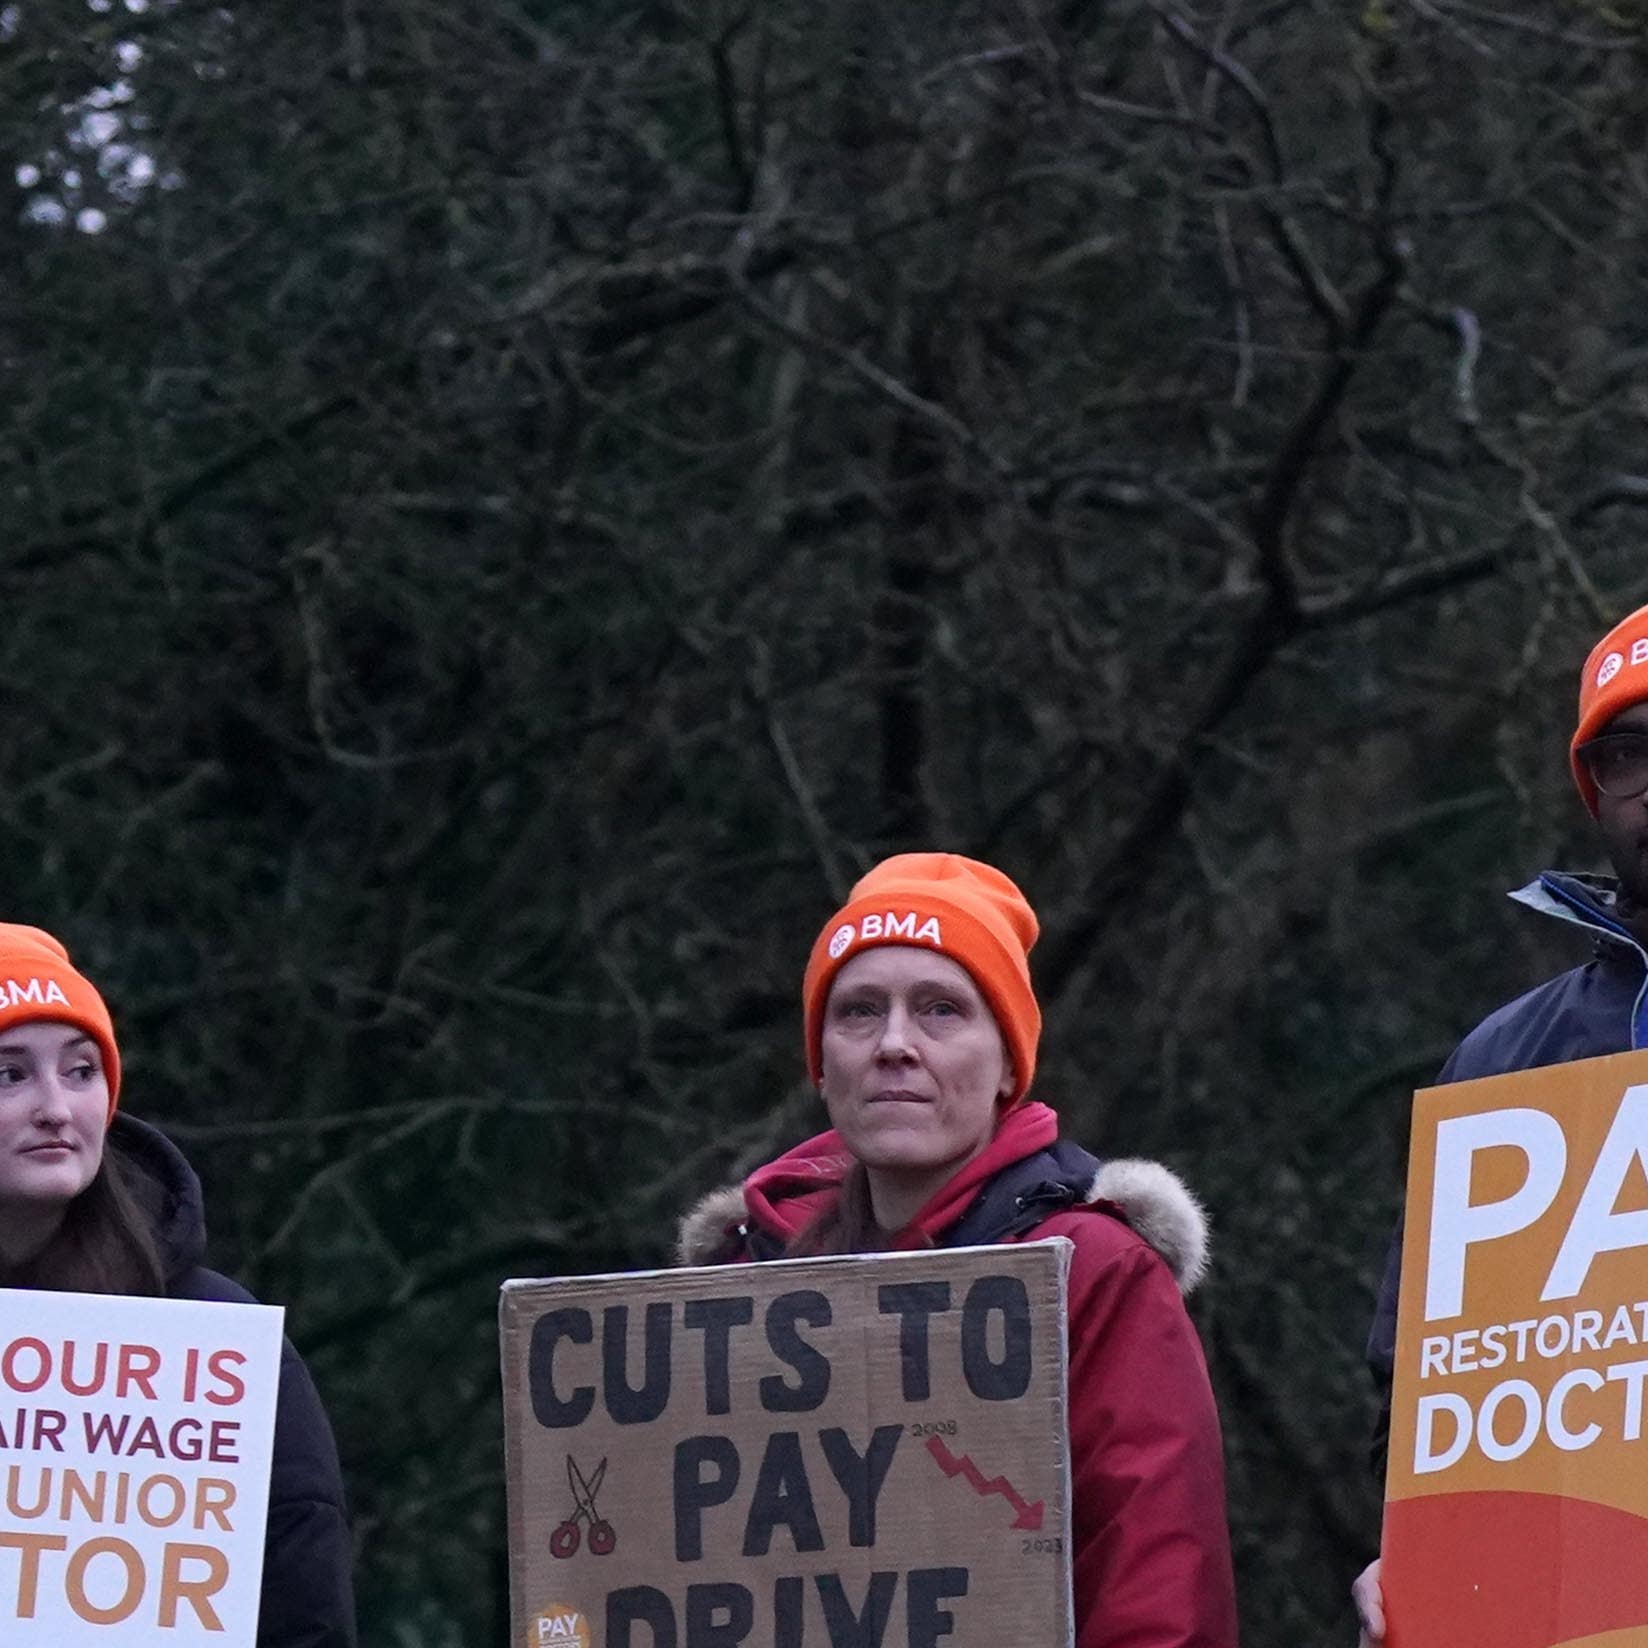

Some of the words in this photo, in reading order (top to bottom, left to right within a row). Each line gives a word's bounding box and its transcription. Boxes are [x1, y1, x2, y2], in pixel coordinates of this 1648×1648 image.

[860, 912, 941, 944] BMA
[184, 1348, 248, 1405] IS
[528, 1289, 833, 1428] CUTS
[878, 1276, 1032, 1403] TO
[82, 1413, 242, 1464] WAGE
[673, 1424, 905, 1562] PAY
[538, 1613, 578, 1638] PAY
